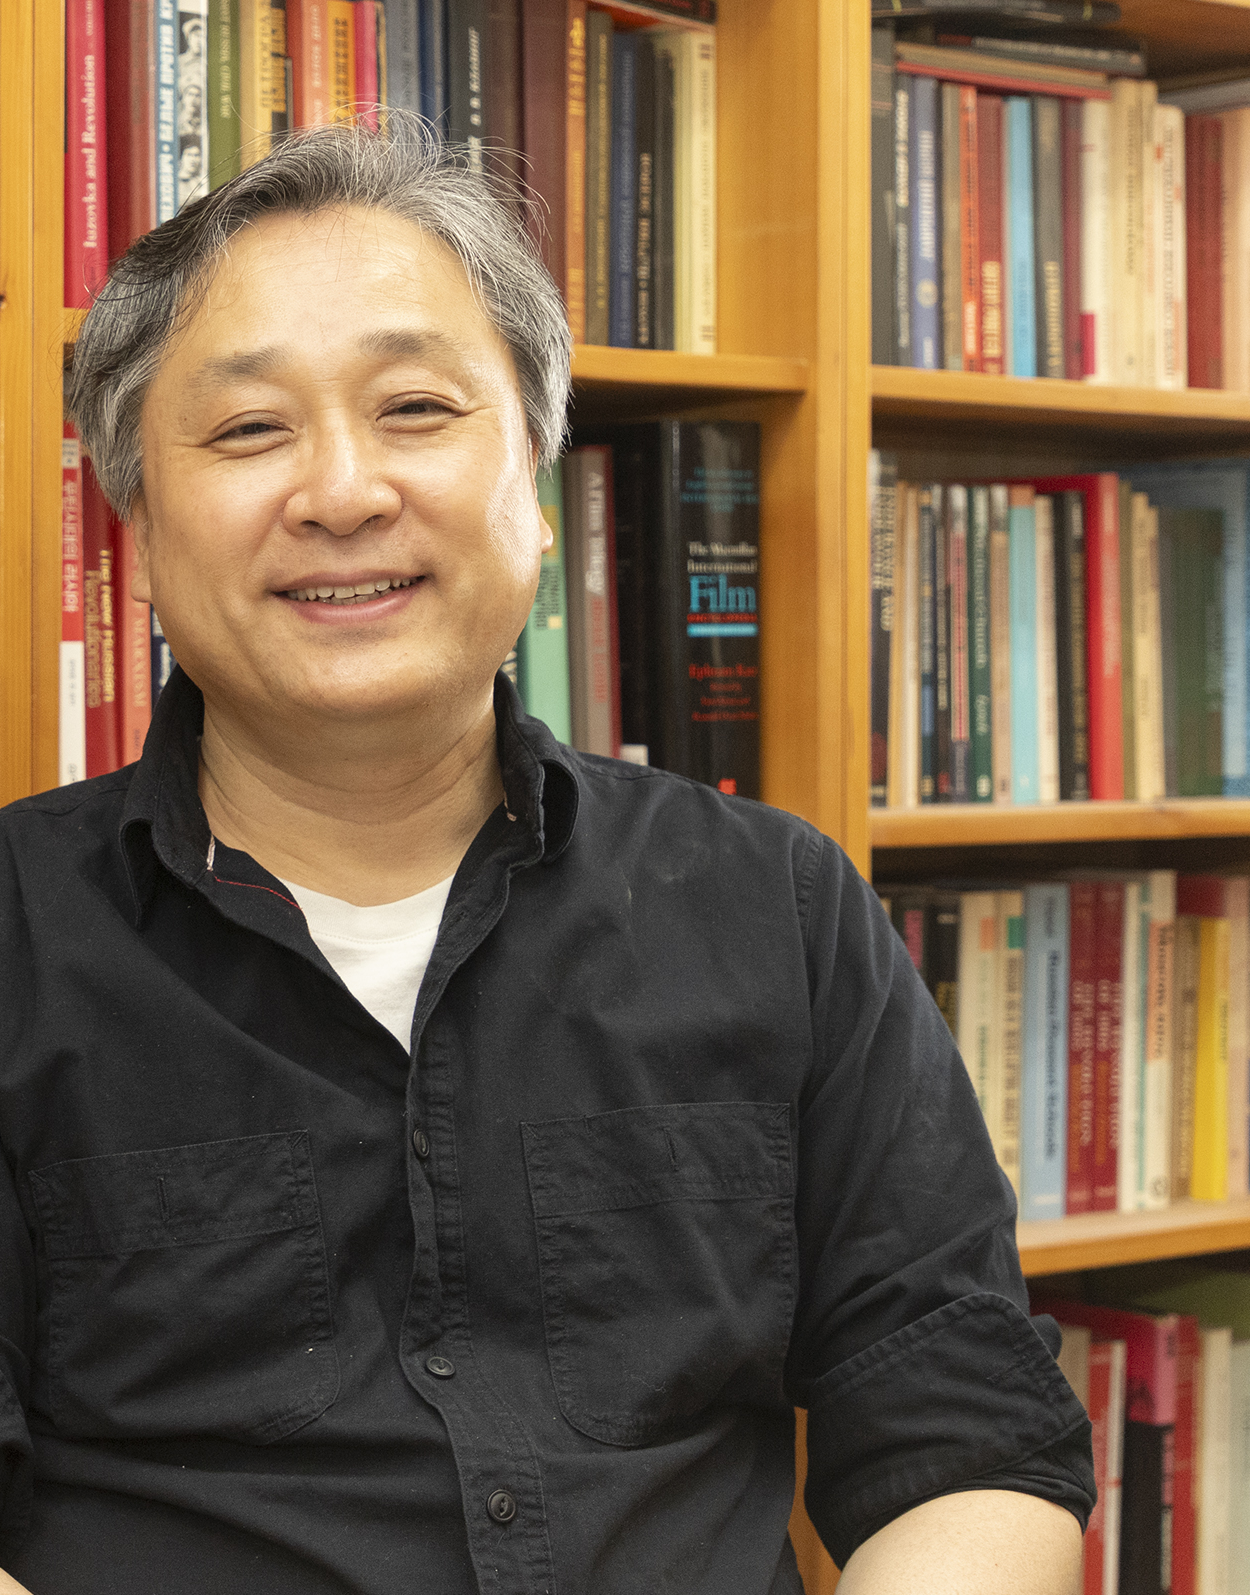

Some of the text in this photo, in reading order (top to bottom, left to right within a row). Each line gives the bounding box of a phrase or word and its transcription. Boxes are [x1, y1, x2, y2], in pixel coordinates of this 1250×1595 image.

[80, 55, 97, 144] Revolution
[81, 149, 98, 179] and
[690, 573, 757, 613] Film
